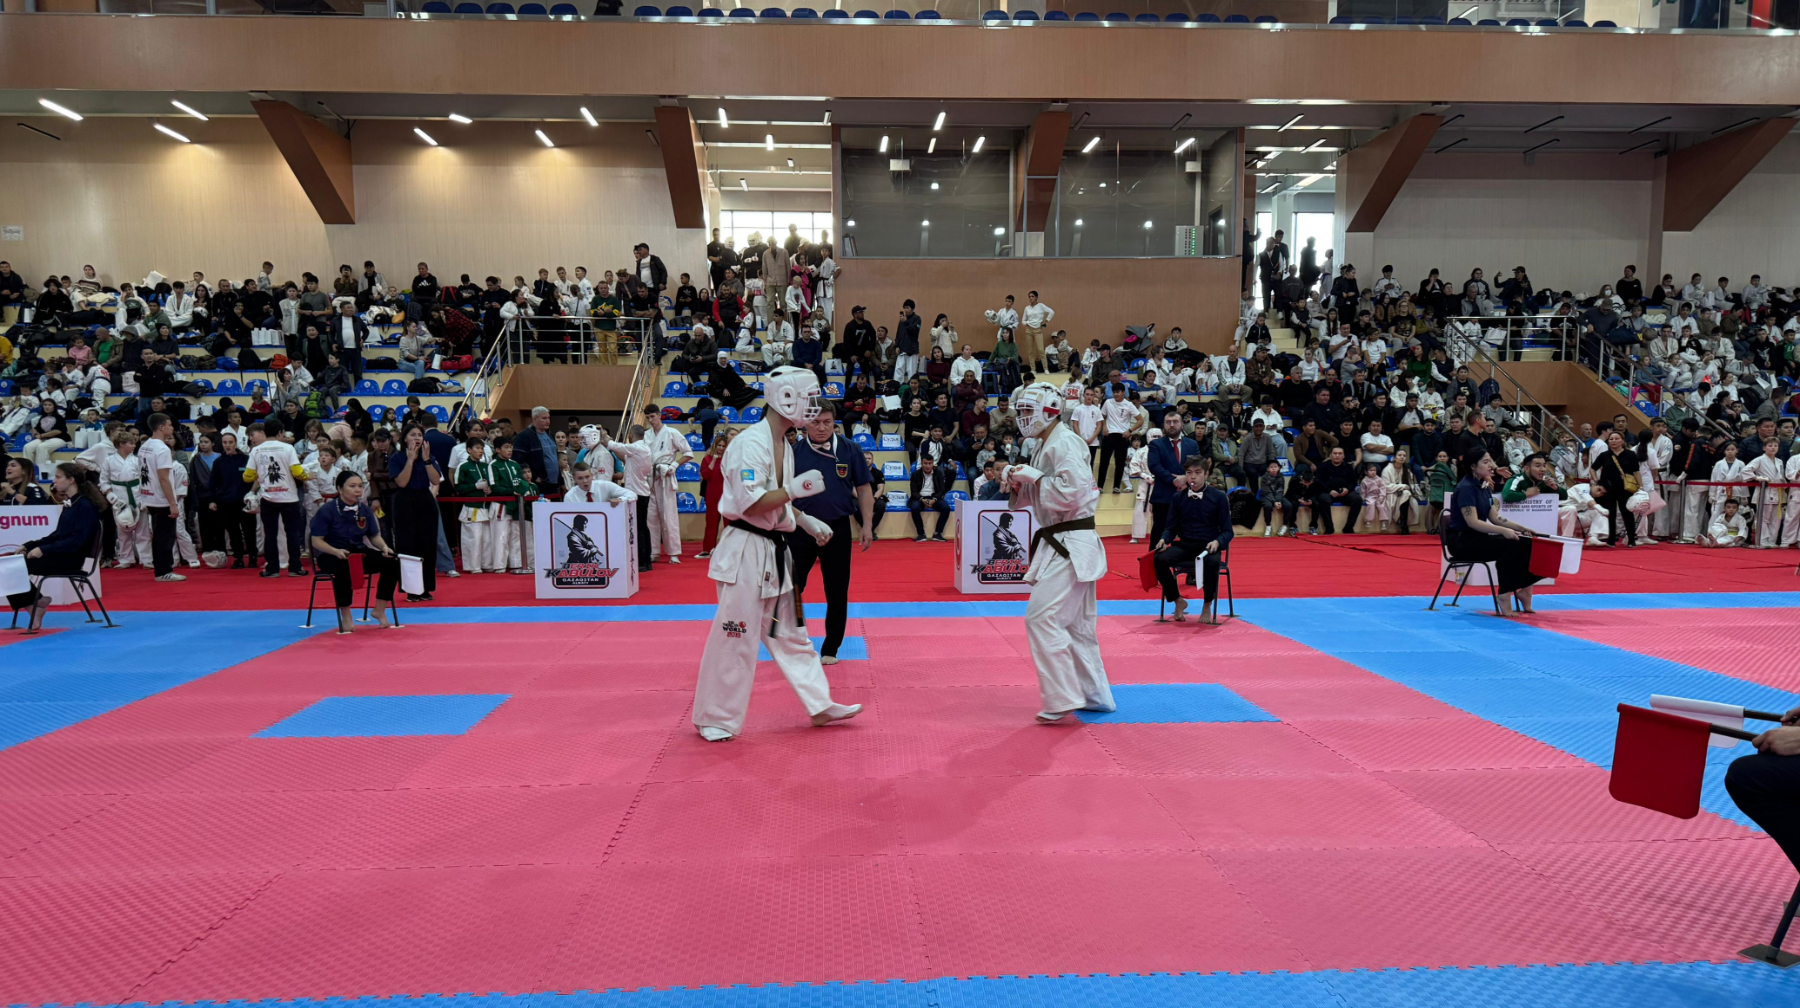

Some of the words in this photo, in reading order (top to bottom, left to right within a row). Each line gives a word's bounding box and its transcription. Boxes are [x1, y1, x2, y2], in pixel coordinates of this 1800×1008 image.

[855, 330, 867, 346] 7
[543, 568, 619, 578] KABULOV
[970, 564, 1030, 574] KABULO
[722, 626, 747, 634] WORLD
